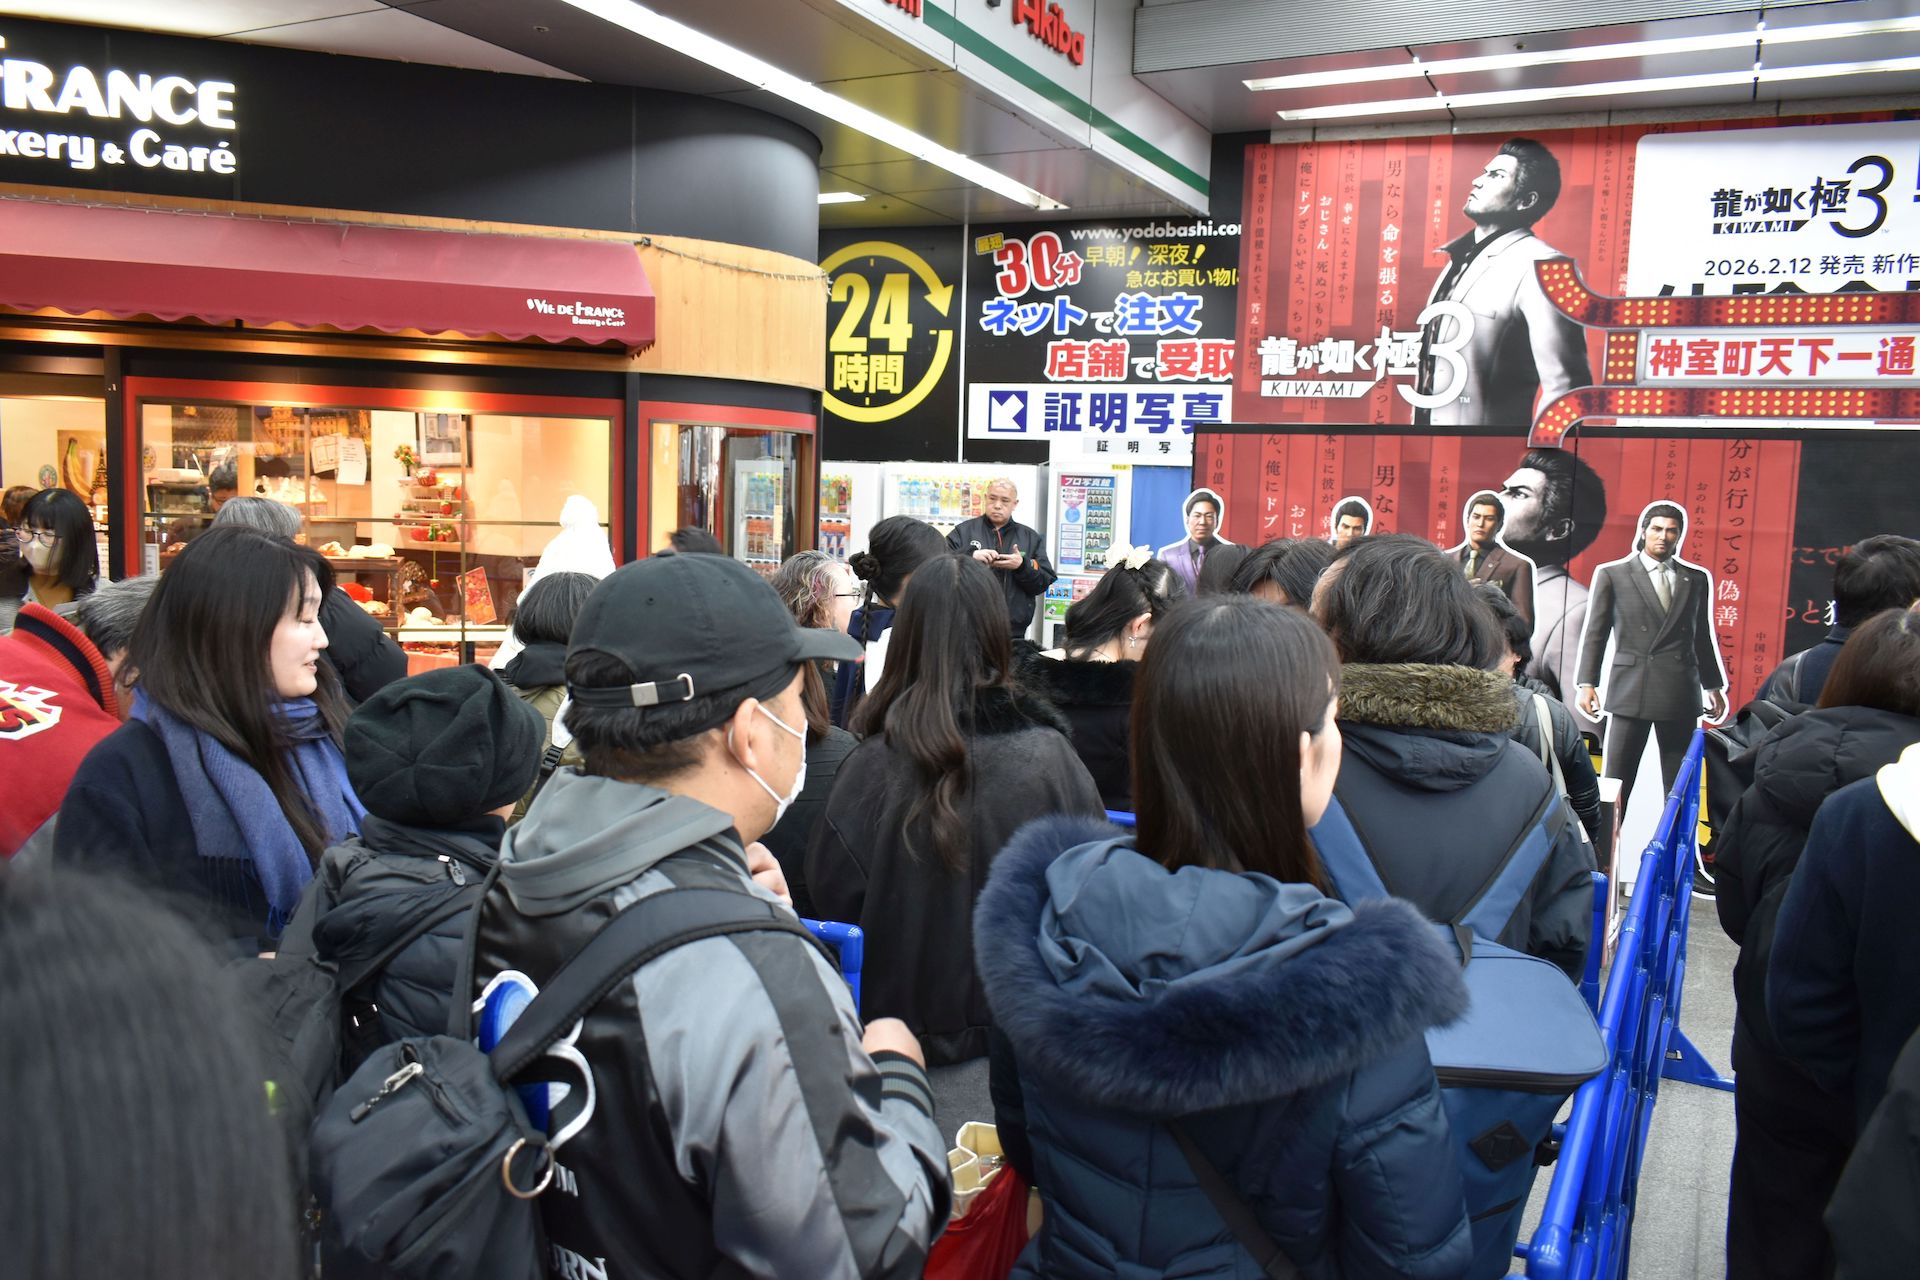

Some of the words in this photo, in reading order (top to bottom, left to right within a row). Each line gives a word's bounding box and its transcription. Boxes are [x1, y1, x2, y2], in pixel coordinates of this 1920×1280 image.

[1012, 0, 1086, 66] Akiba
[0, 58, 237, 130] RANCE
[101, 142, 126, 165] &
[129, 128, 237, 174] Café
[1719, 220, 1794, 235] KIWAMI
[994, 231, 1085, 299] 30分
[1704, 258, 1812, 276] 2026.2.12
[1819, 255, 1866, 275] 発売
[829, 272, 914, 353] 24
[980, 292, 1203, 336] ネットで注文
[833, 353, 905, 395] 時間
[1043, 338, 1236, 382] 店舗で受取
[1649, 337, 1917, 377] 神室町天下一通
[1271, 381, 1355, 396] KIWAMI
[1043, 391, 1224, 435] 証明写真
[1096, 439, 1194, 454] 証明写
